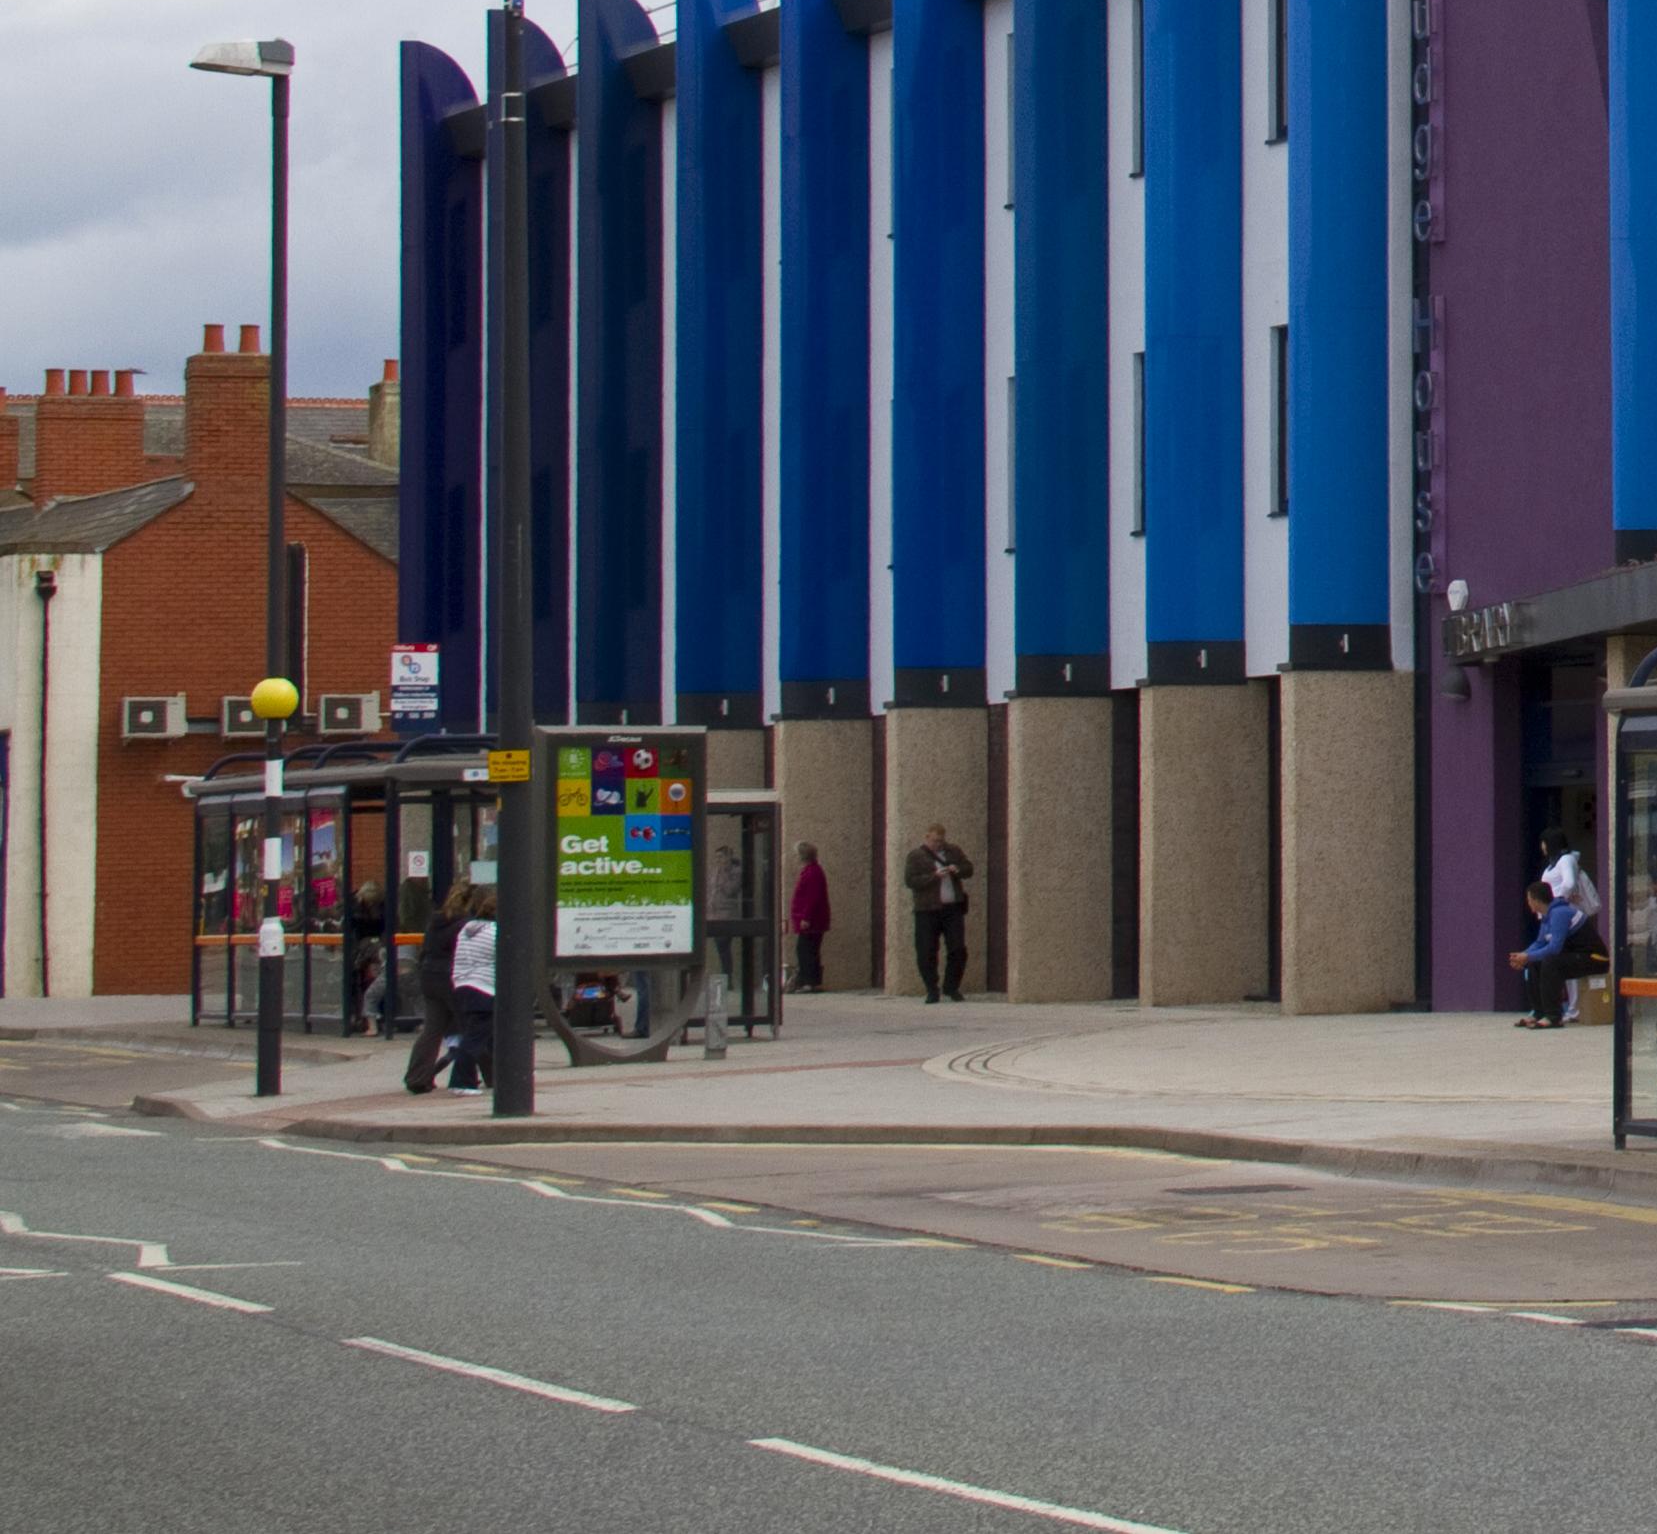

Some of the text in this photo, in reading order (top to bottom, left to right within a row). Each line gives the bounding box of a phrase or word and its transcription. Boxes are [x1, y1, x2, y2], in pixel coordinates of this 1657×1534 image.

[561, 834, 609, 854] Get
[560, 856, 662, 875] active...
[1154, 1210, 1596, 1254] BUS
